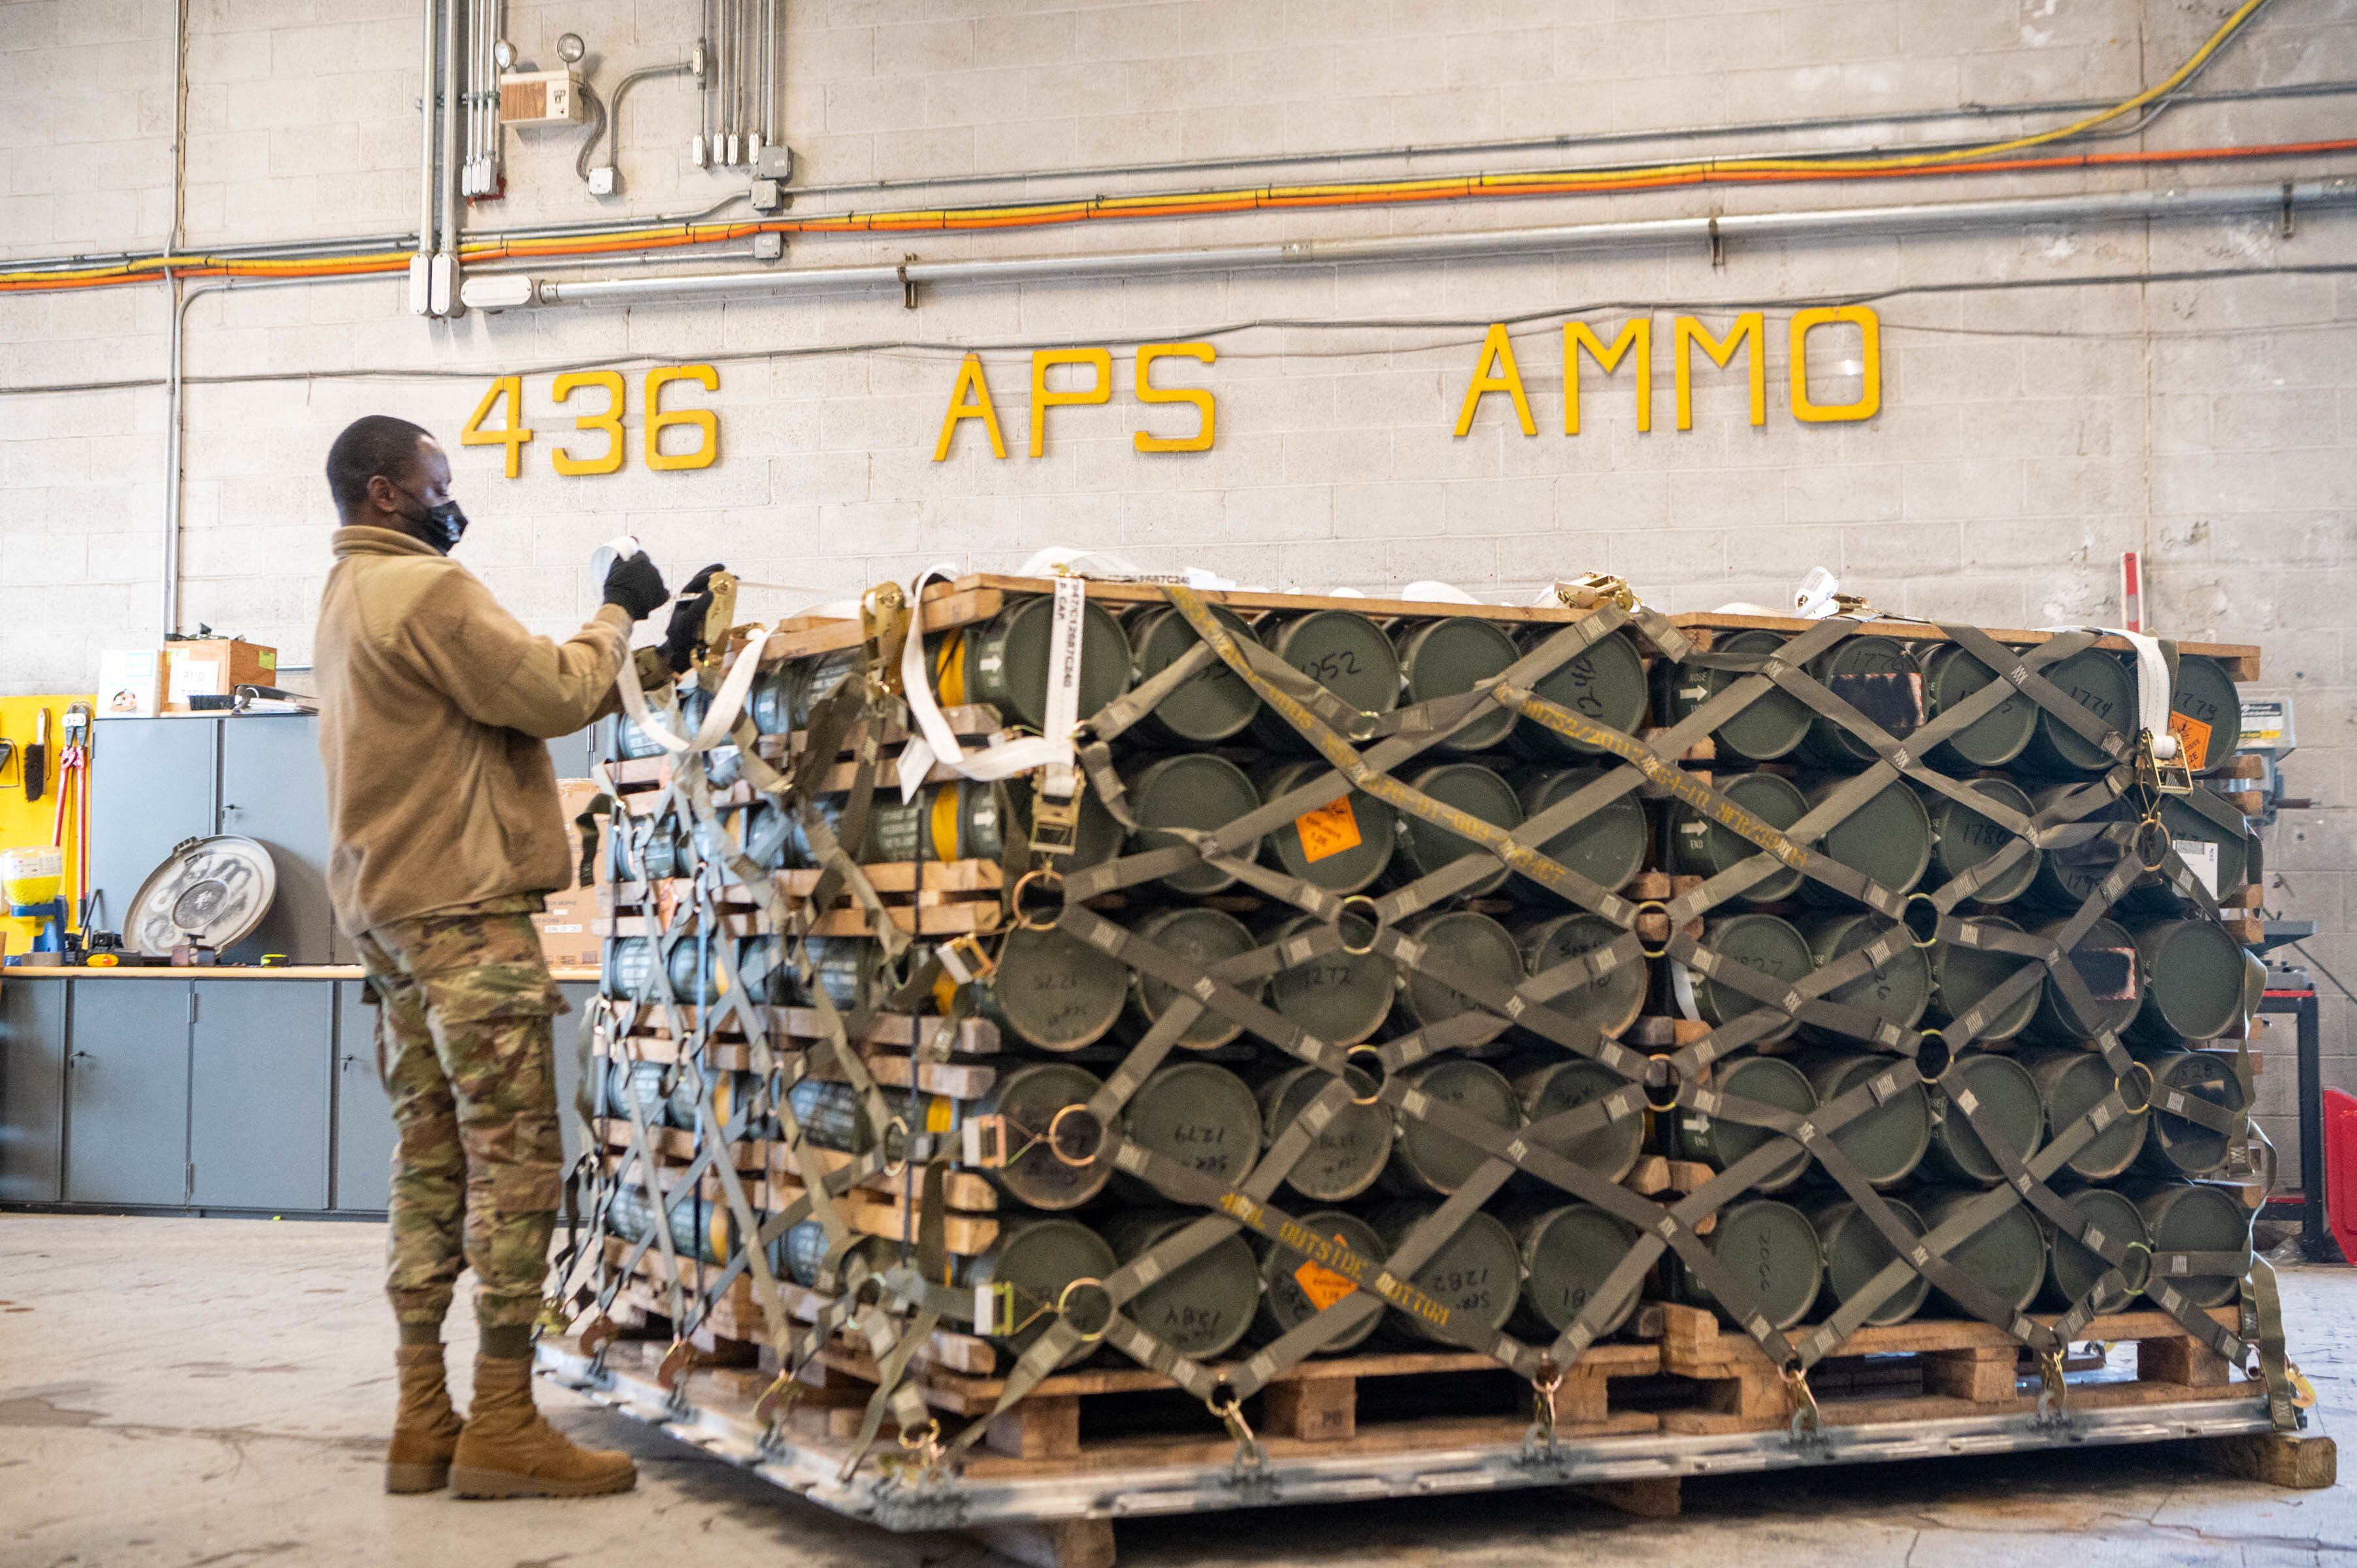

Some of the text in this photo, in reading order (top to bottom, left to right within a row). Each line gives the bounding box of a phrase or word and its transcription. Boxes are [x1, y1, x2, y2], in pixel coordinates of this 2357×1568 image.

[461, 306, 1881, 478] 436 APS AMMO
[2185, 738, 2201, 753] OSIVE
[1380, 1279, 1451, 1327] OTTOM
